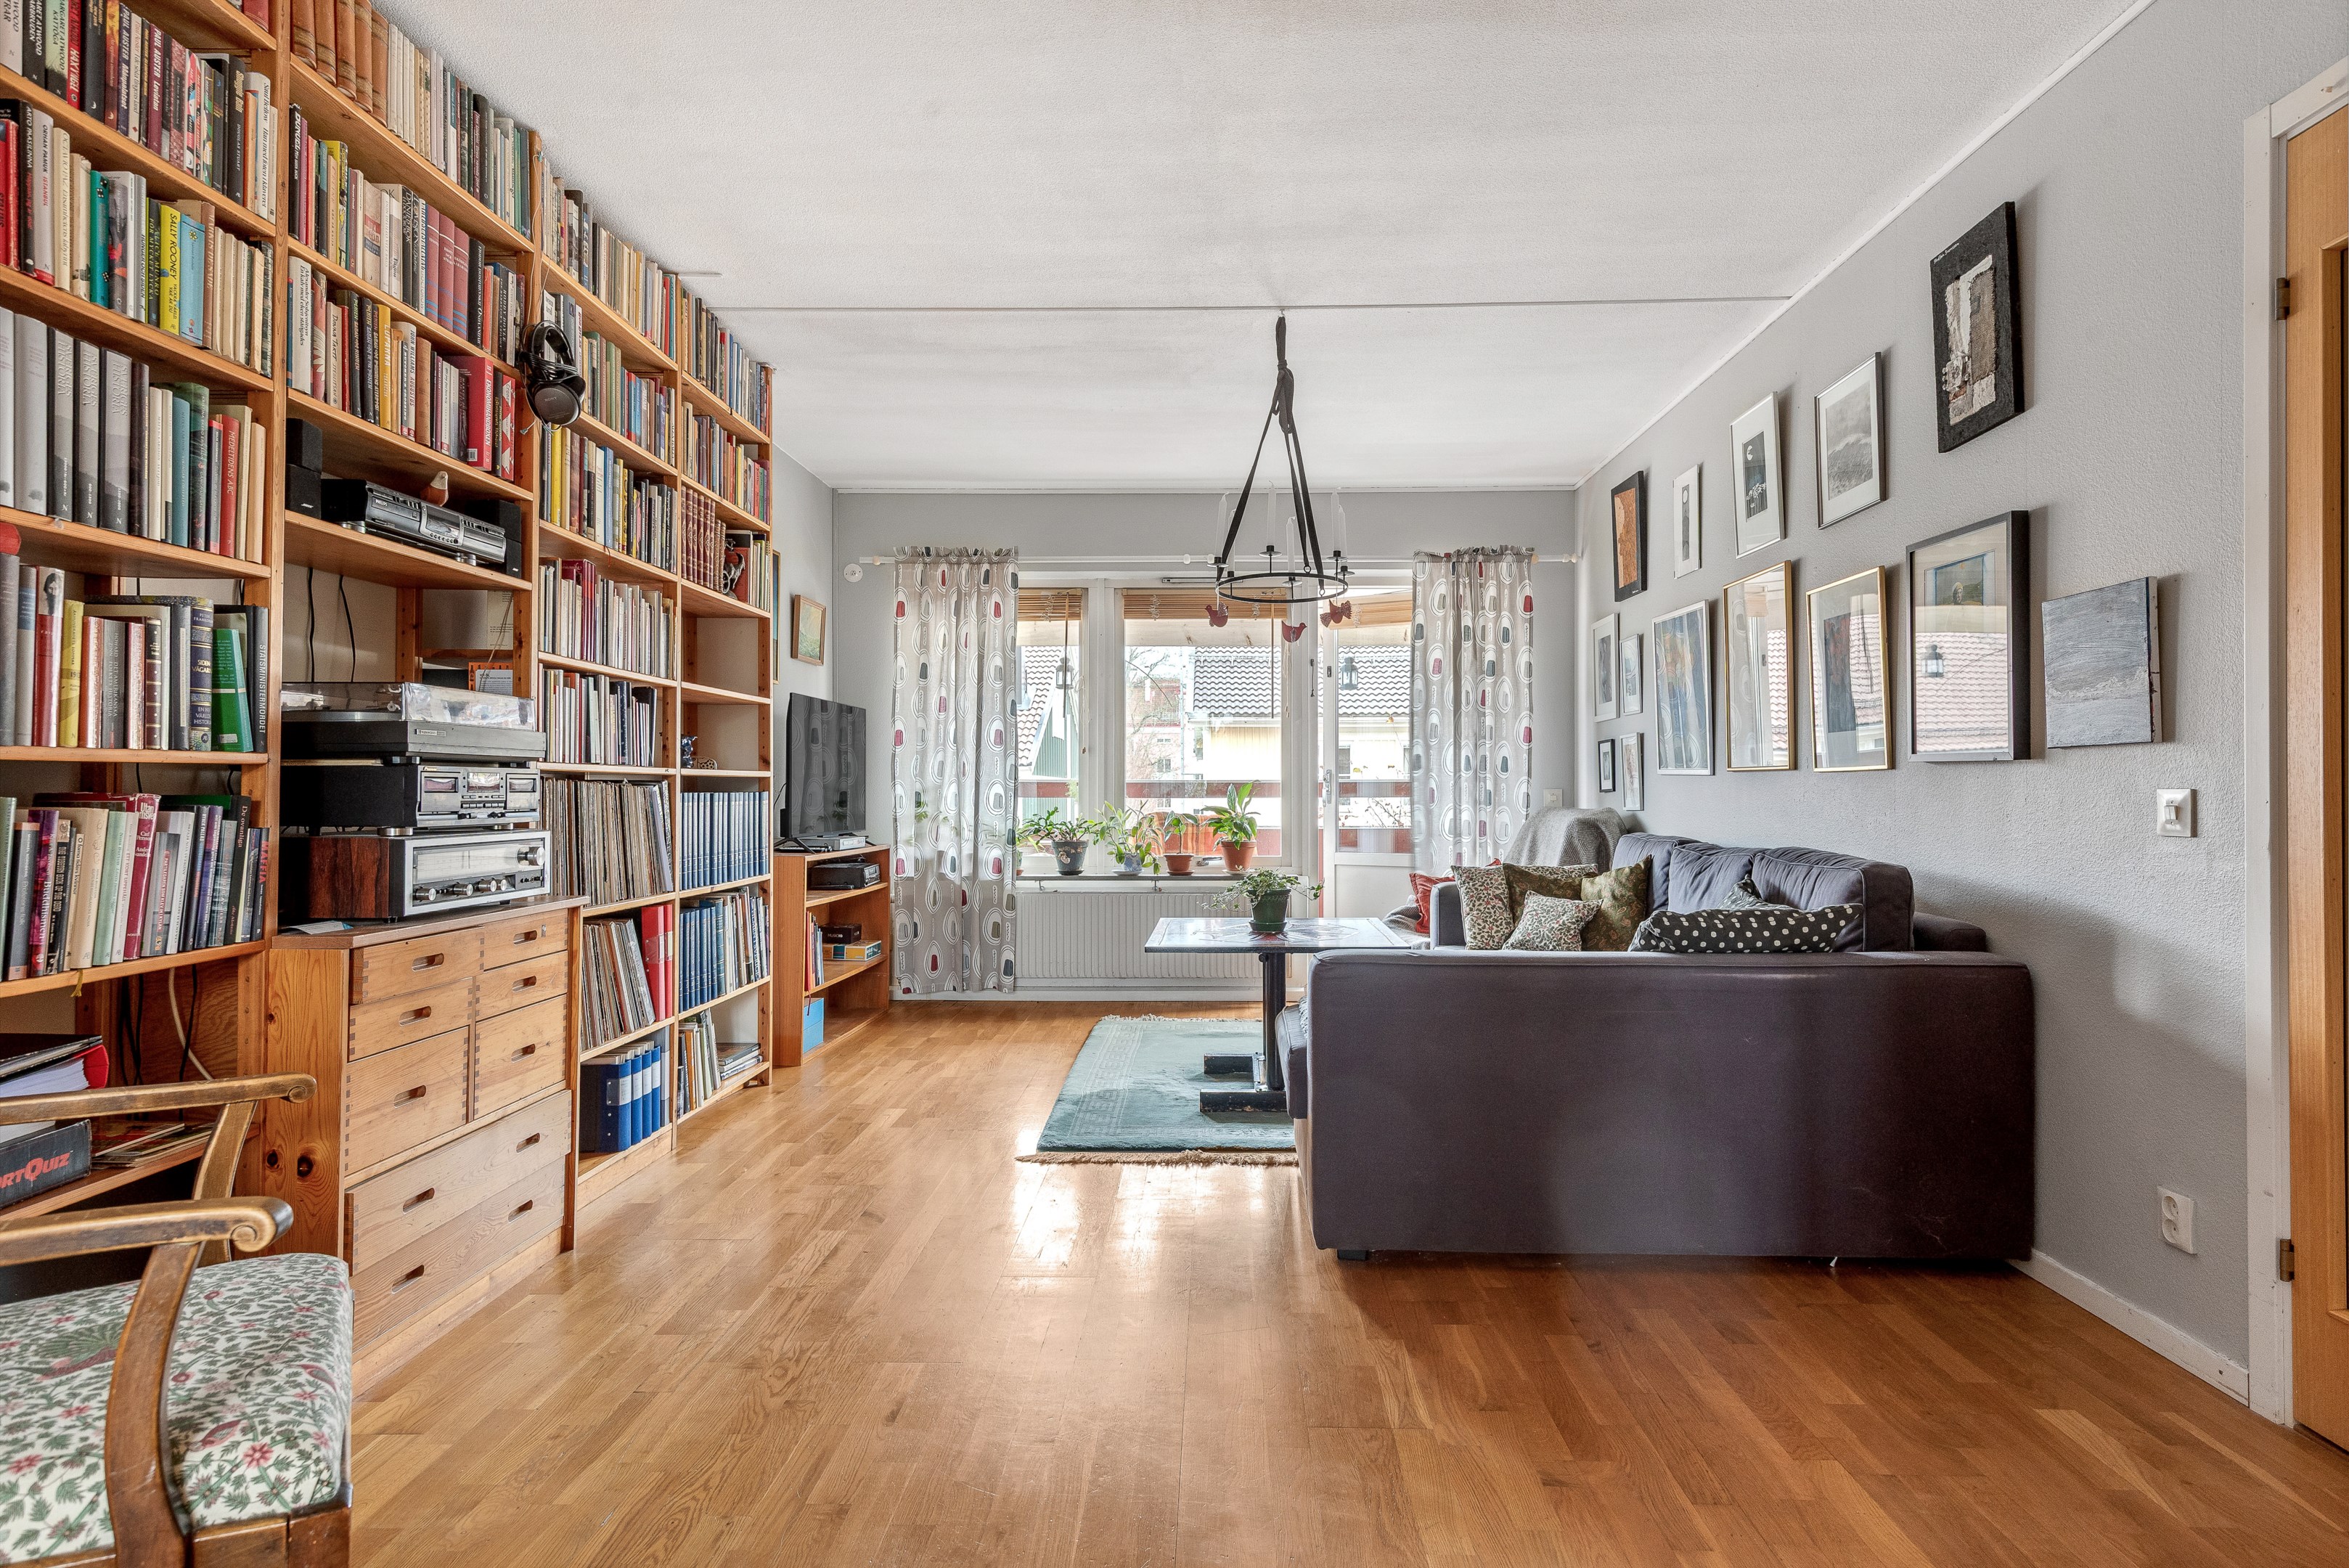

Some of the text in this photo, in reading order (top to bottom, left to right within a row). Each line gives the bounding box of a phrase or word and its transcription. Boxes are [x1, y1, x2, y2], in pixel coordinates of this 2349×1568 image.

[120, 62, 128, 109] Månpalatset
[234, 70, 245, 96] Shuggie
[234, 97, 245, 113] Bain
[57, 342, 66, 396] HISTORIA
[81, 353, 91, 407] HISTORIA
[111, 363, 120, 415] HISTORIA
[120, 364, 128, 417] SVERIGES
[226, 430, 235, 478] MEDELTIDENS
[241, 806, 248, 817] De
[258, 840, 269, 883] MAFFIA
[38, 881, 52, 940] Buddhismen
